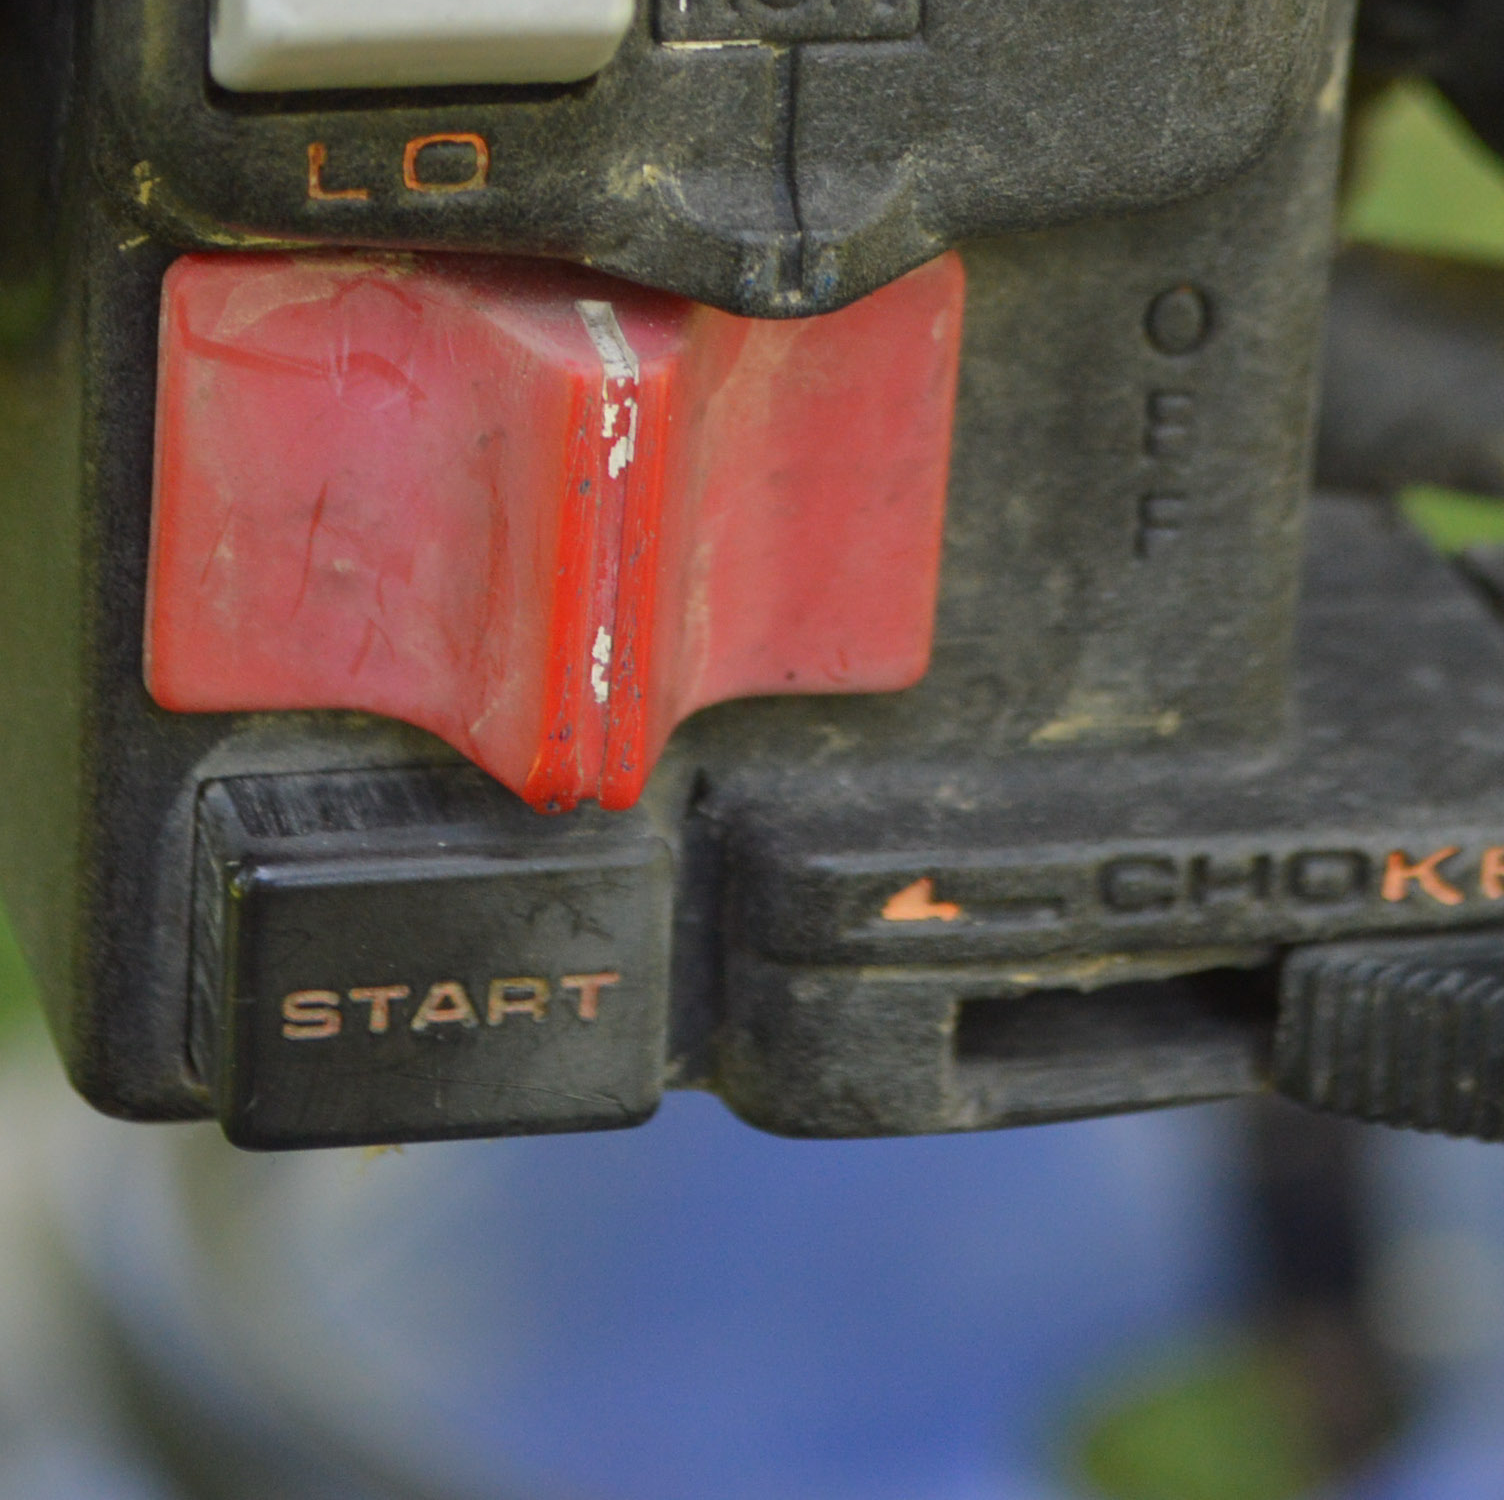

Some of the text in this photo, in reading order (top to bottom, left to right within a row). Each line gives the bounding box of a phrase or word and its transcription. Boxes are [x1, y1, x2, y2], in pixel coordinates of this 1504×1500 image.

[307, 132, 490, 201] LO
[1132, 281, 1214, 558] OFF
[281, 971, 622, 1041] START
